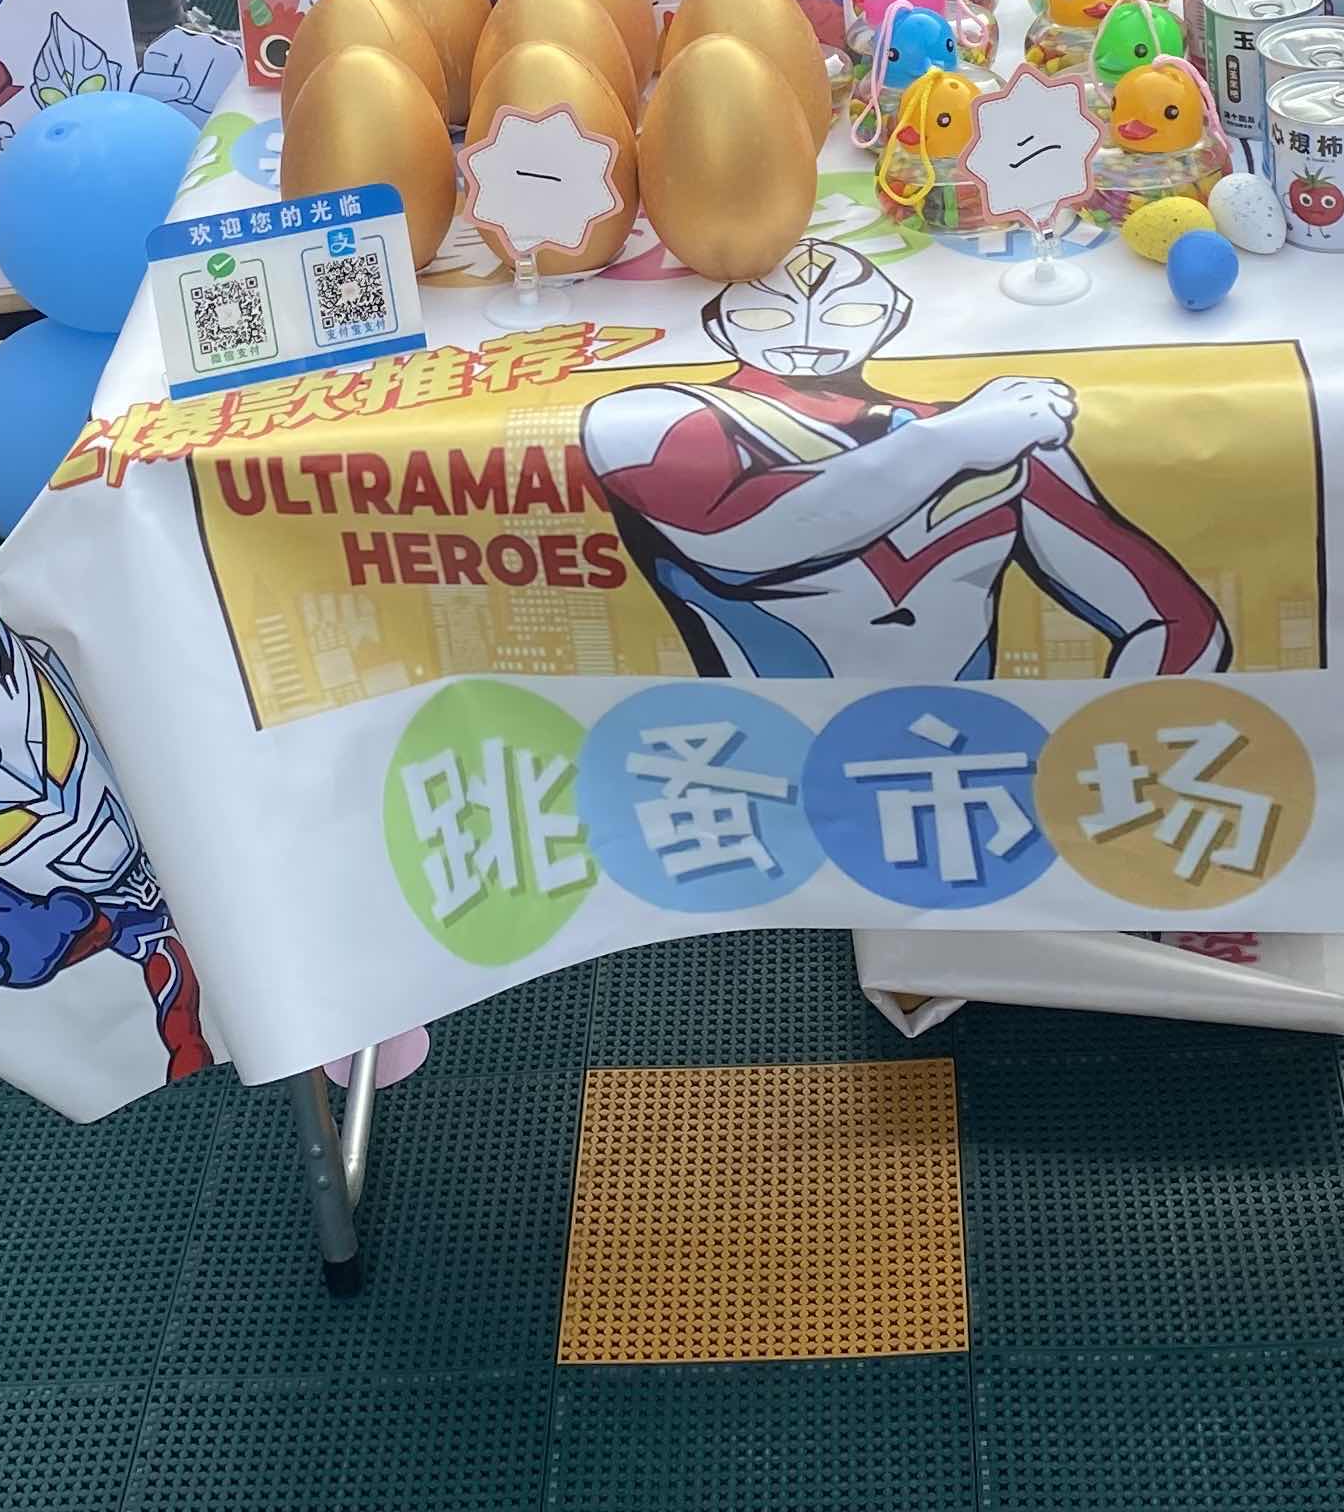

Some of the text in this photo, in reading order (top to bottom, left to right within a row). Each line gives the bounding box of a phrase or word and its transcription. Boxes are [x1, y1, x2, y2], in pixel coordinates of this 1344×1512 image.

[1233, 31, 1256, 51] 玉
[1008, 135, 1062, 169] 二
[189, 194, 362, 246] 欢迎您的光临
[326, 320, 387, 342] 支付宝支付
[211, 347, 261, 365] 微信支付
[340, 530, 628, 590] HEROES
[402, 714, 1284, 928] 跳蚤市场
